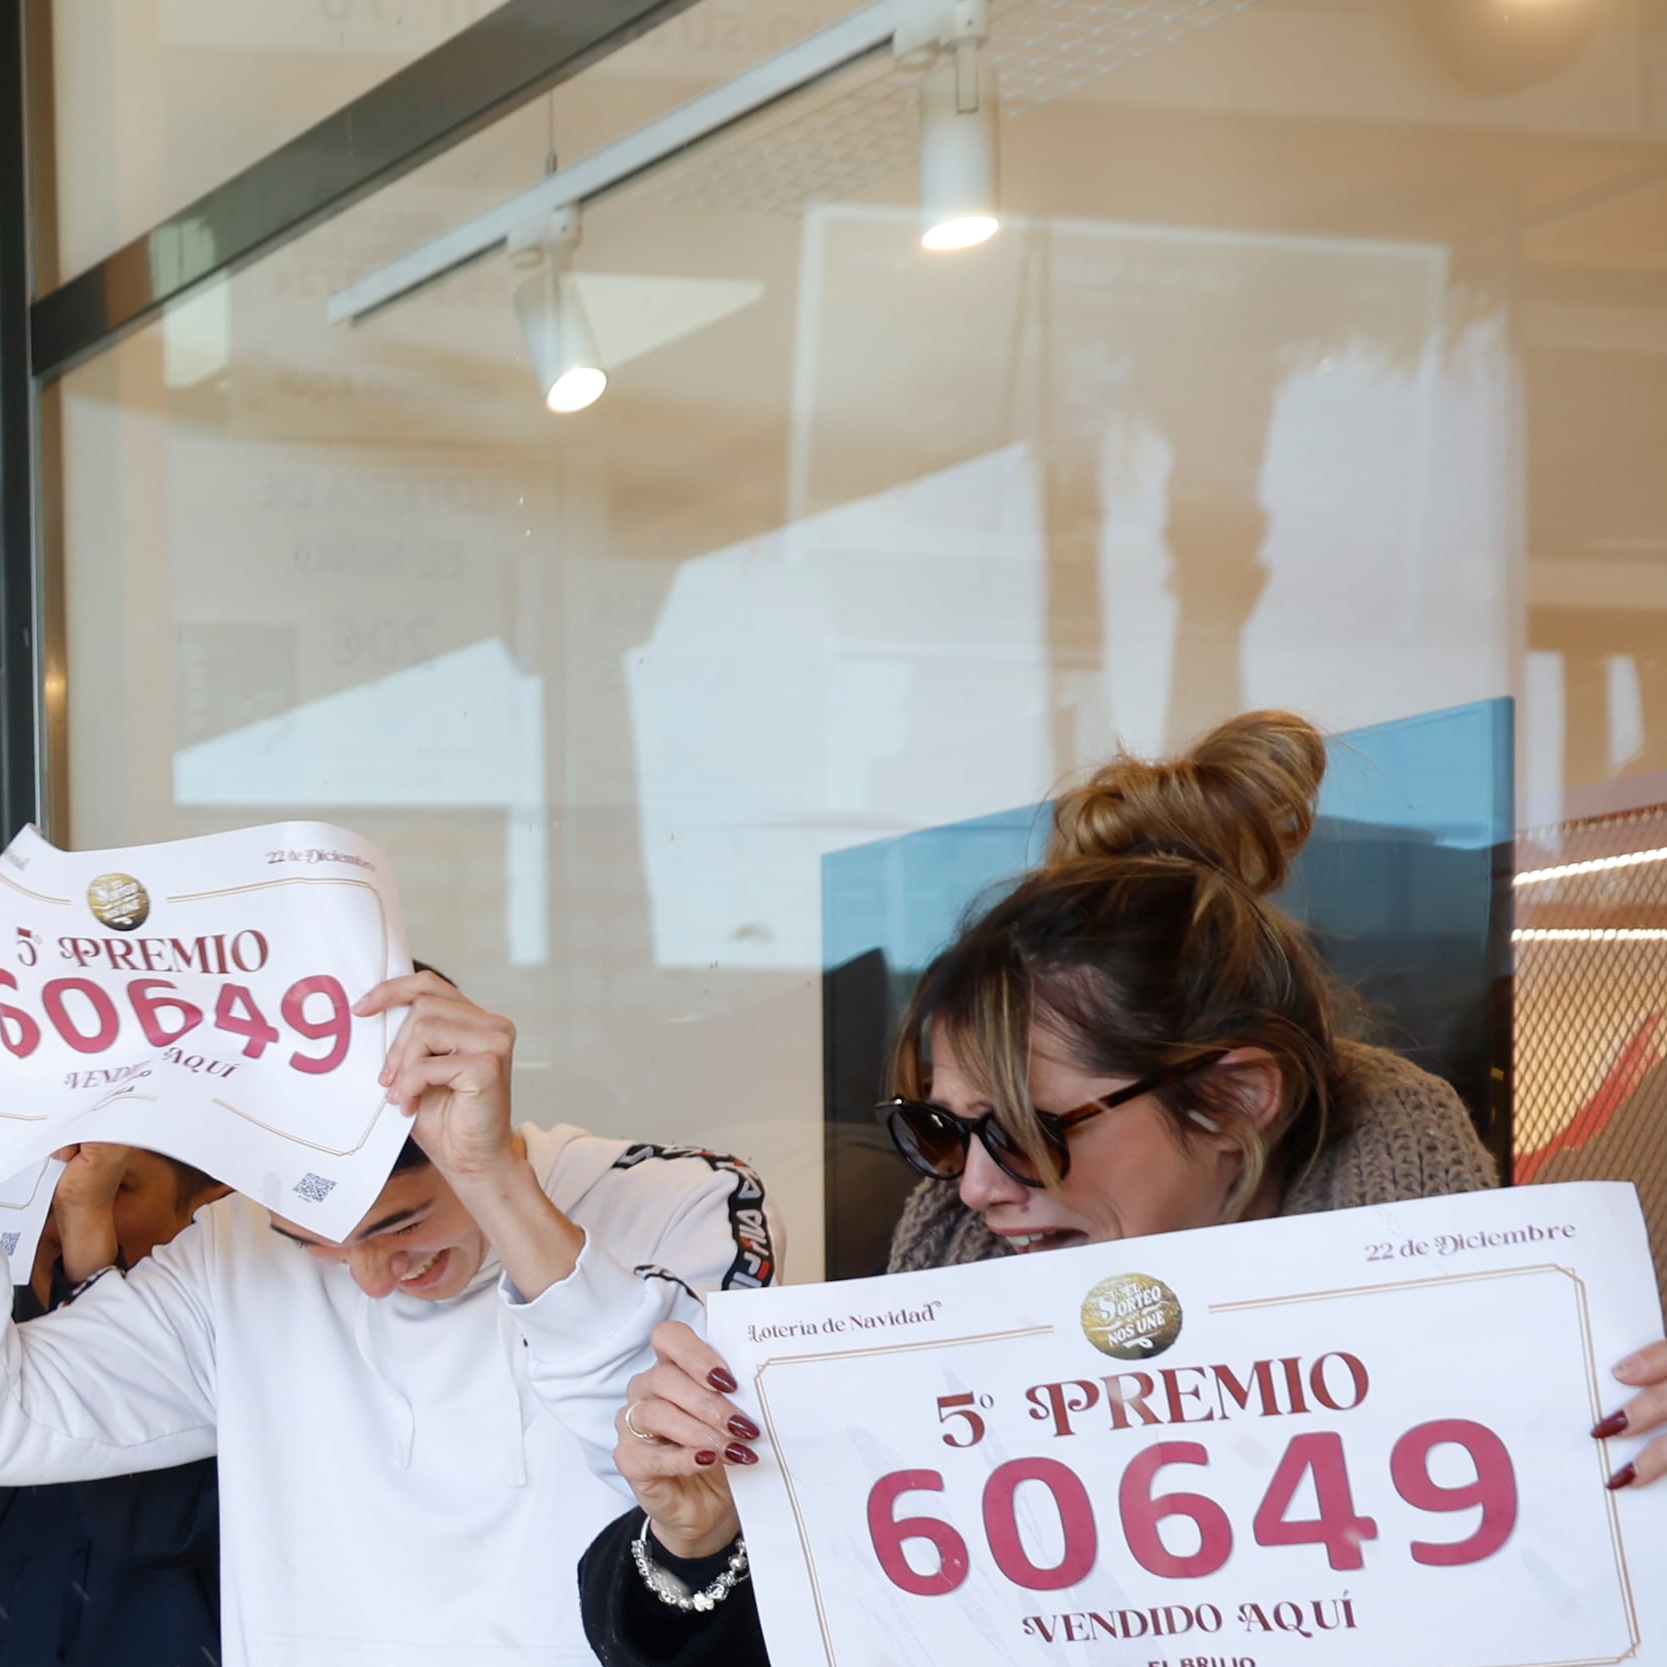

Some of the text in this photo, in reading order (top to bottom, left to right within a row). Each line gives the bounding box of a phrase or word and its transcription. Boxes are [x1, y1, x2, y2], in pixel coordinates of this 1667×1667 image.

[267, 851, 285, 864] 22
[58, 929, 269, 975] PREMIO
[164, 1047, 241, 1079] AQUÍ
[1364, 1223, 1576, 1262] 22 de Diciembre
[1097, 1285, 1162, 1320] SORTEO
[1121, 1283, 1141, 1297] EL
[823, 1316, 846, 1334] de
[850, 1301, 942, 1330] Navidad
[1108, 1310, 1166, 1348] NOS UNE
[1024, 1350, 1369, 1438] PREMIO
[866, 1417, 1520, 1597] 60649
[1022, 1589, 1359, 1643] VENDIDO AQUÍ
